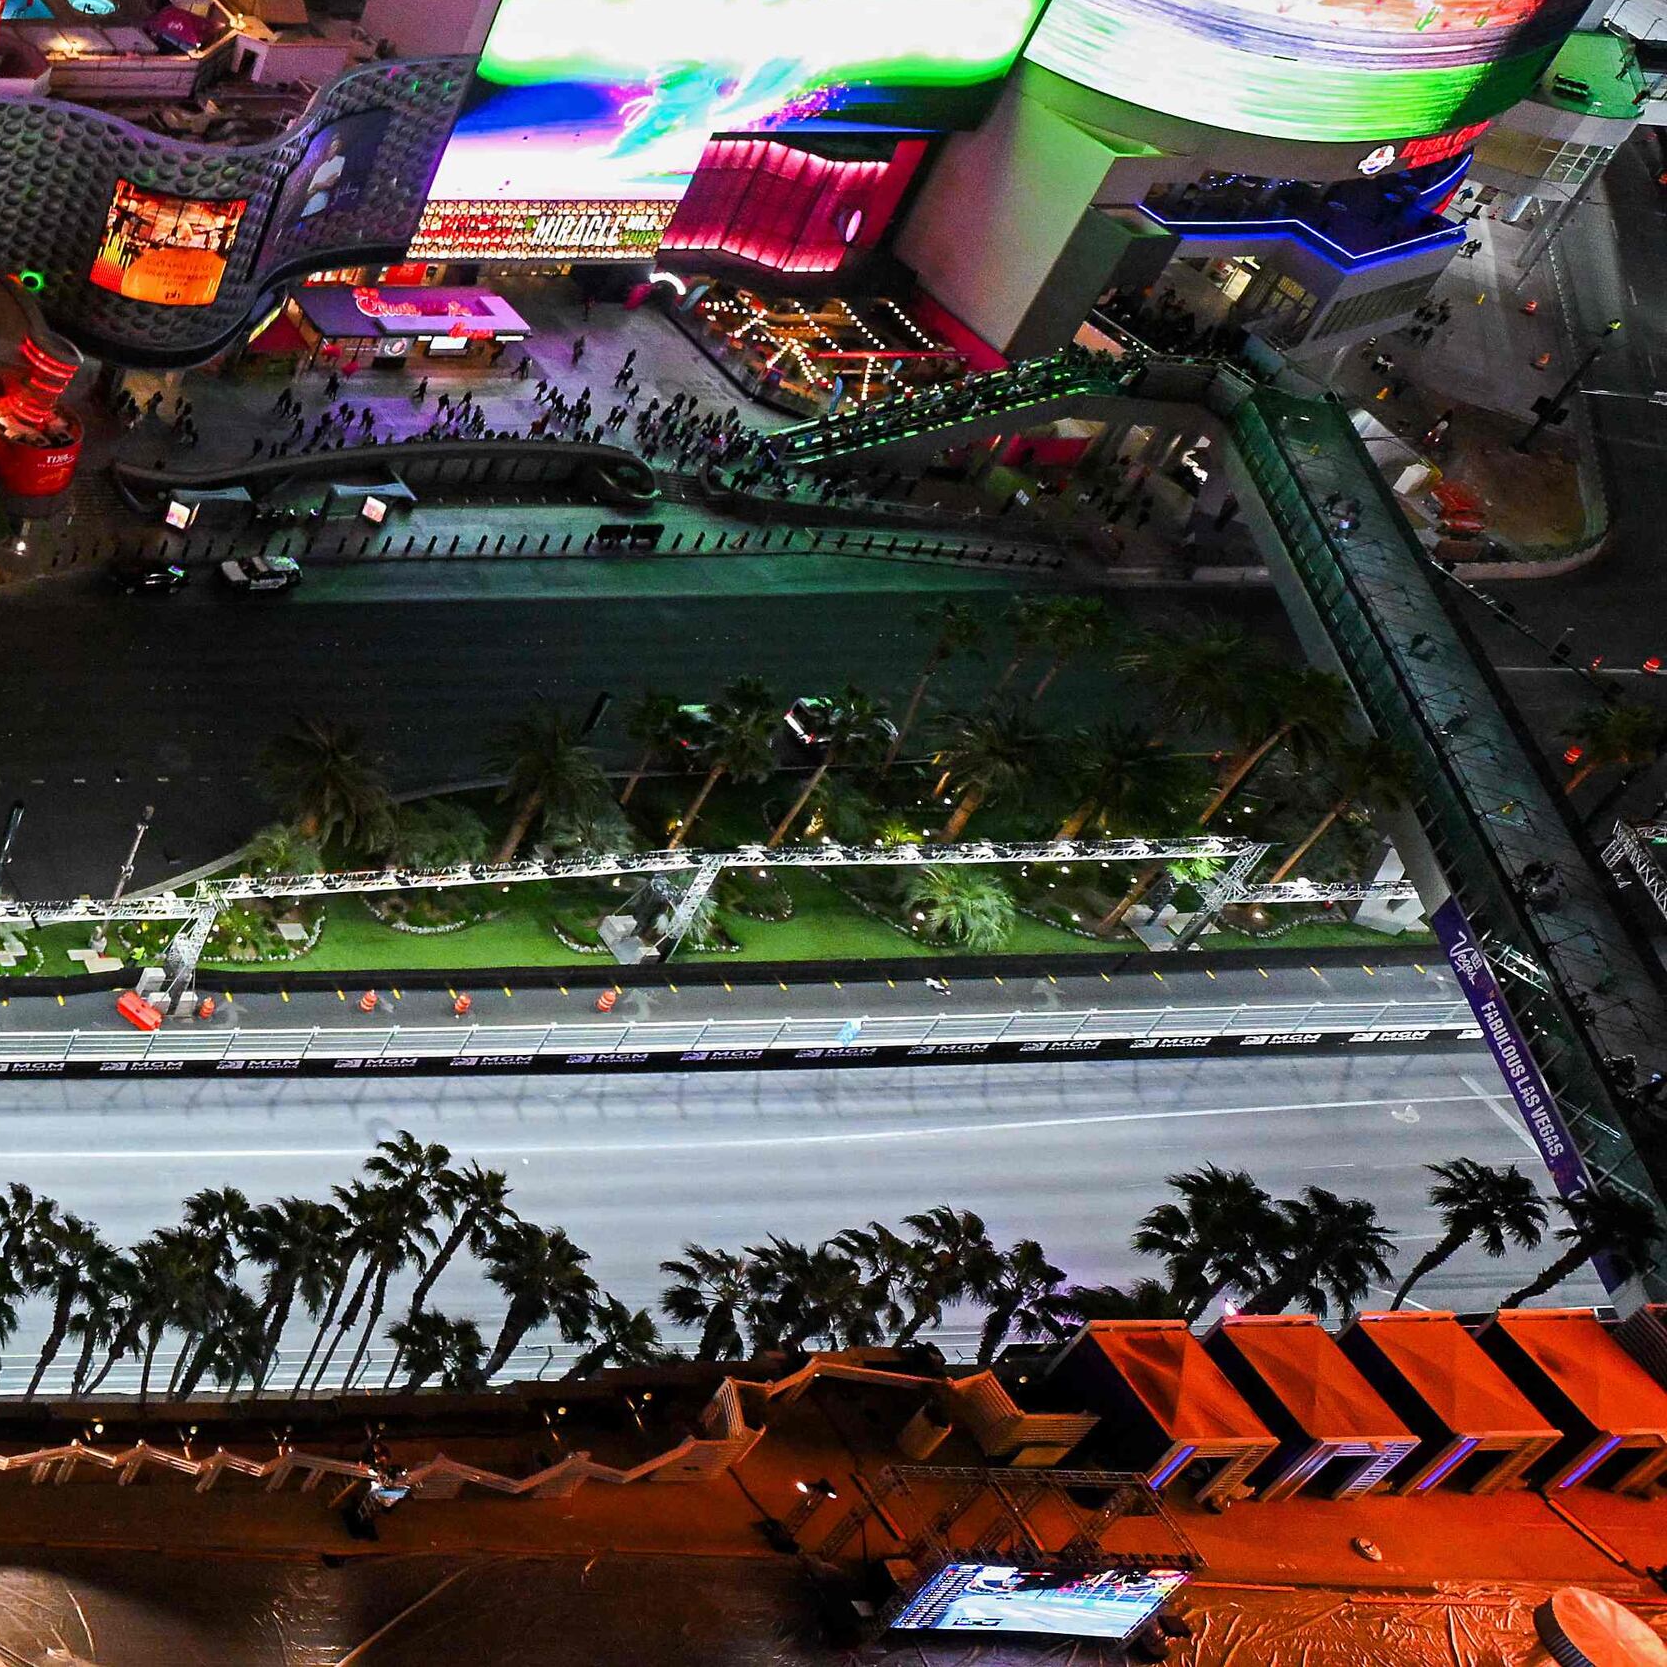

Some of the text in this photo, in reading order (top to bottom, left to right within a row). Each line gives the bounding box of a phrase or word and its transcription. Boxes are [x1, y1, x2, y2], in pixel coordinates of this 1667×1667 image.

[532, 215, 625, 247] MIRACLE
[1481, 1000, 1565, 1158] FABULOUS LAS VEGAS
